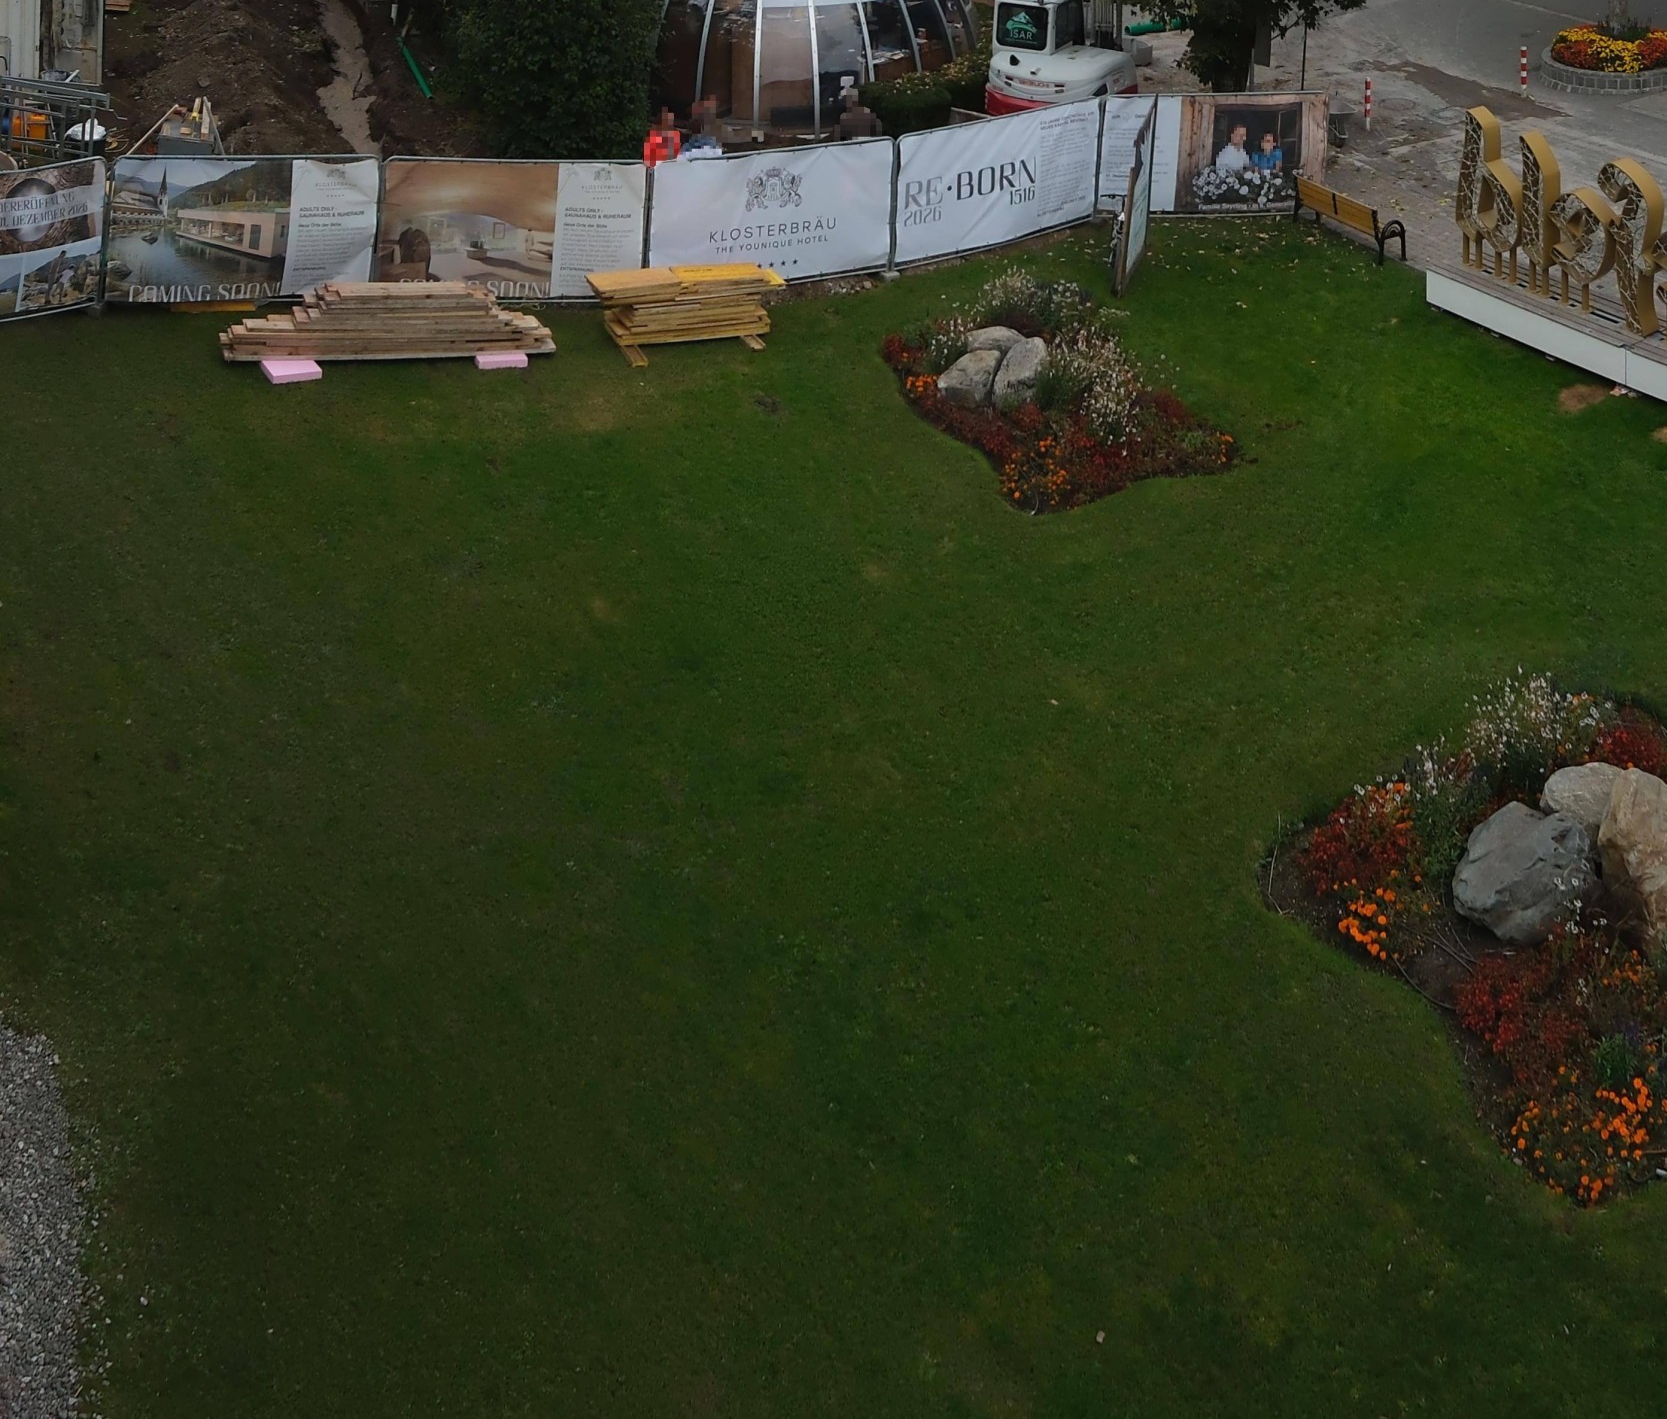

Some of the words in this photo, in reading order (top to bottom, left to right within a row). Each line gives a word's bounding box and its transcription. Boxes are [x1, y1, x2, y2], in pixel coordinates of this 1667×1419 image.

[1010, 30, 1032, 41] ISAR
[1009, 185, 1036, 206] 1516
[13, 208, 66, 226] DEZEMBER
[903, 206, 942, 227] 2026
[709, 215, 837, 244] KLOSTERBRÄU
[715, 246, 734, 254] THE
[739, 239, 793, 252] YOUNIQUE
[797, 235, 829, 246] HOTEL
